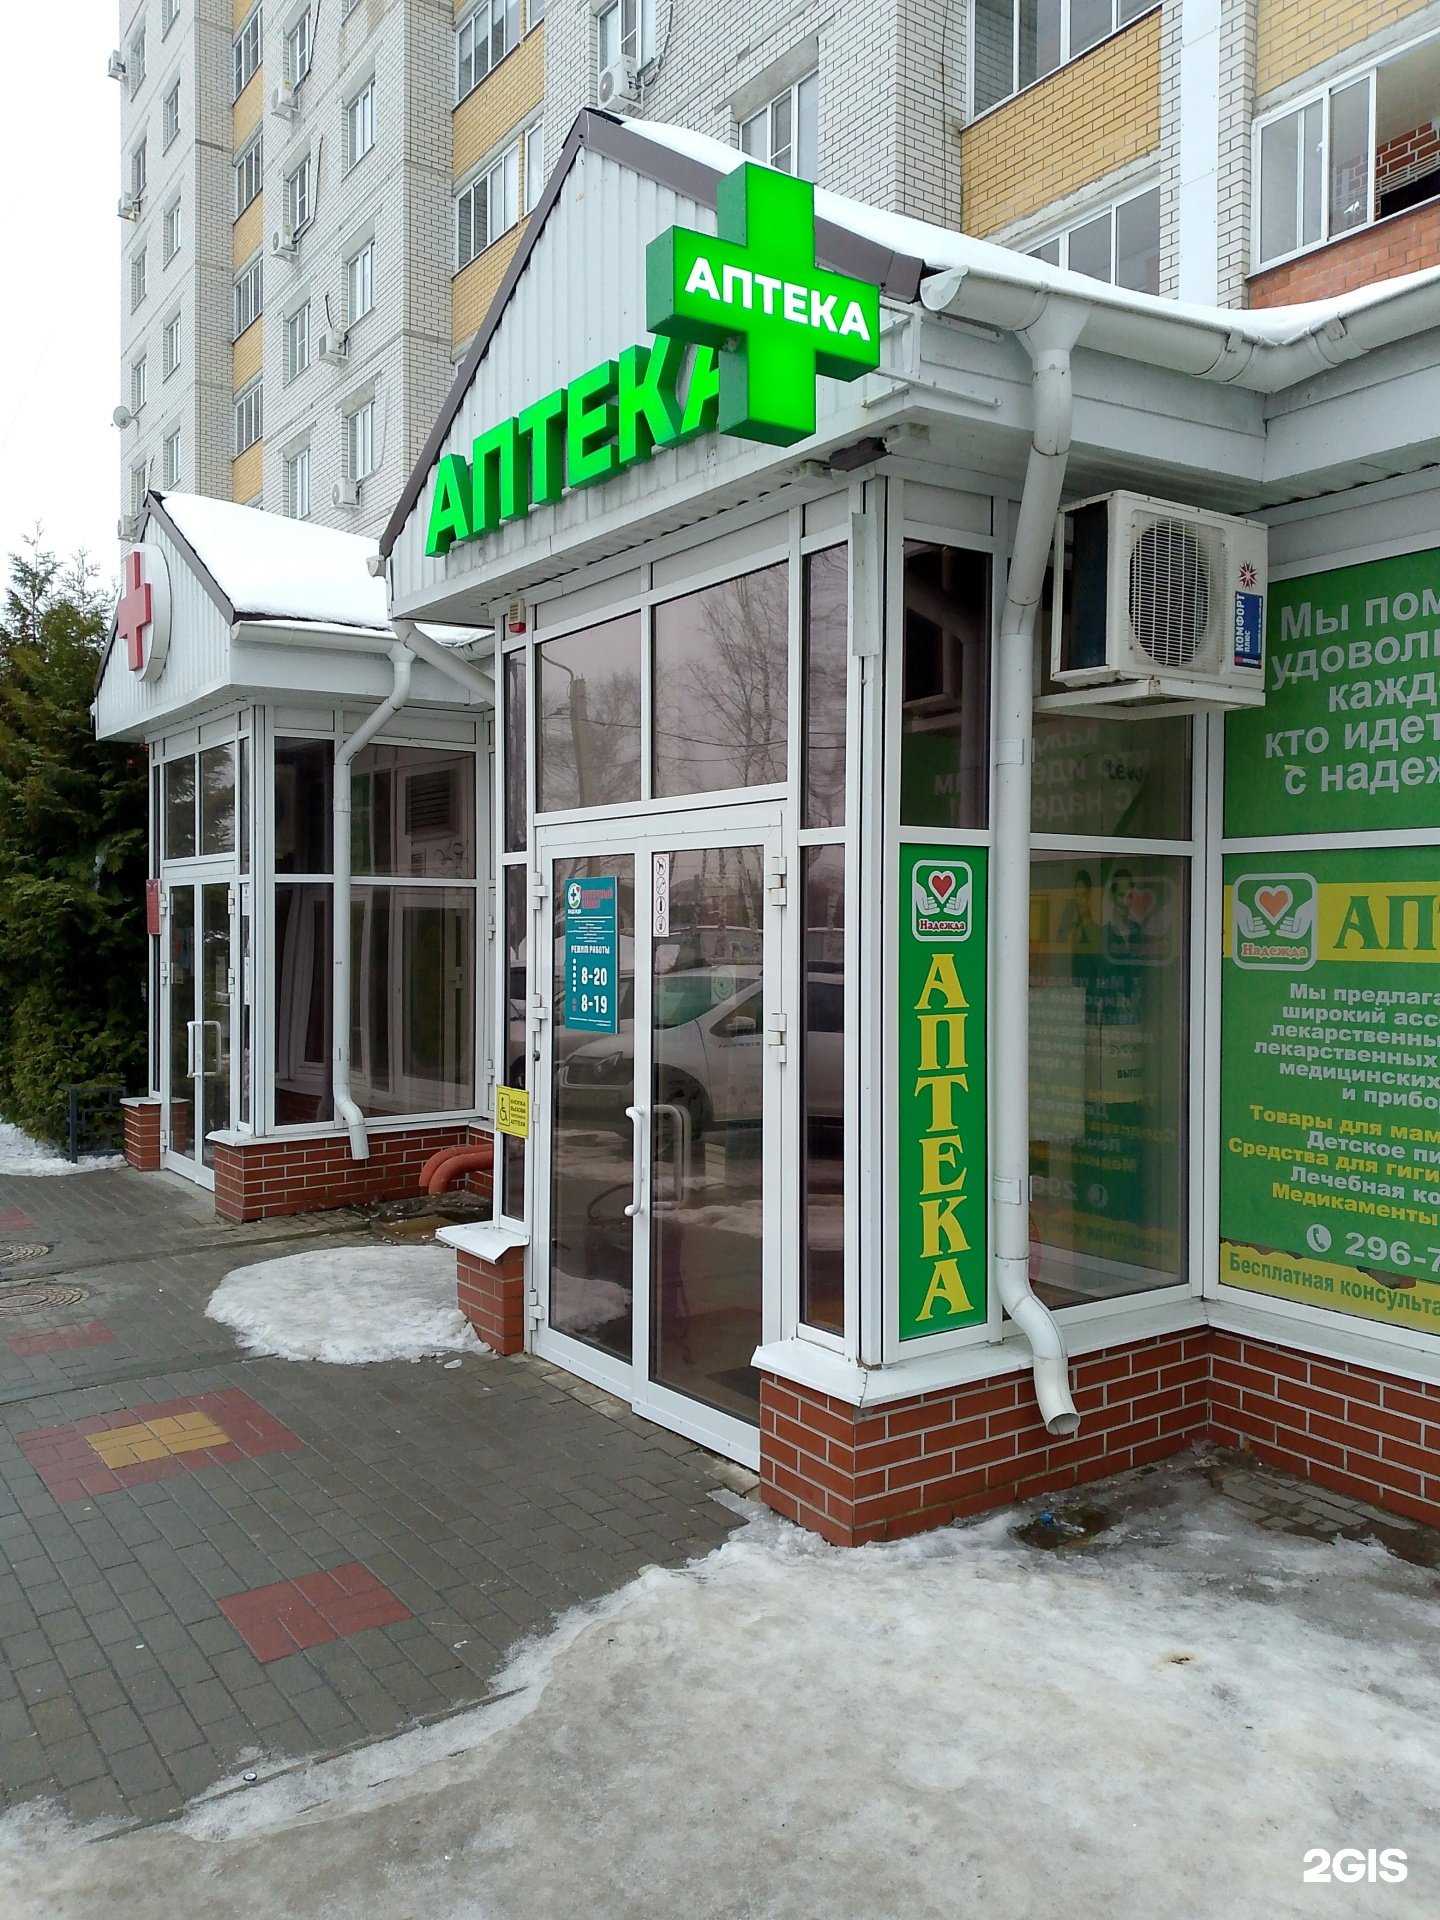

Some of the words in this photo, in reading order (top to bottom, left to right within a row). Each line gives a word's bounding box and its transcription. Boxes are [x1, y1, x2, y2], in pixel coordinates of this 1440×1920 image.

[685, 257, 870, 341] АПТЕКА
[1235, 593, 1246, 652] КОМФОРТ
[1281, 602, 1349, 641] Мы
[1271, 630, 1440, 690] удовол
[1329, 671, 1440, 712] кажд
[1265, 726, 1329, 759] кто
[1344, 712, 1440, 754] идет
[1285, 765, 1306, 795] с
[919, 919, 966, 932] Надежда
[1333, 895, 1440, 950] АП
[581, 966, 607, 986] 8-20
[1290, 983, 1325, 1000] Мы
[581, 994, 607, 1014] 8-19
[1282, 1006, 1386, 1025] широкий
[1394, 1011, 1440, 1028] асс
[1254, 1041, 1438, 1068] лекарственных
[1279, 1063, 1440, 1089] медицинских
[1342, 1087, 1355, 1101] и
[1364, 1089, 1440, 1111] прибо
[914, 953, 974, 1322] АПТЕКА
[1250, 1104, 1333, 1130] Товары
[1339, 1118, 1381, 1136] для
[1390, 1125, 1440, 1144] мам
[1228, 1137, 1329, 1166] Средства
[1335, 1155, 1378, 1174] для
[1387, 1163, 1440, 1184] гиги
[1306, 1131, 1406, 1159] Детское
[1272, 1182, 1437, 1226] Медикаменты
[1290, 1166, 1405, 1200] Лечебная
[1413, 1188, 1440, 1206] ко
[1345, 1232, 1440, 1273] 296-7
[1230, 1252, 1333, 1292] Бесплатная
[1341, 1279, 1440, 1316] консульта
